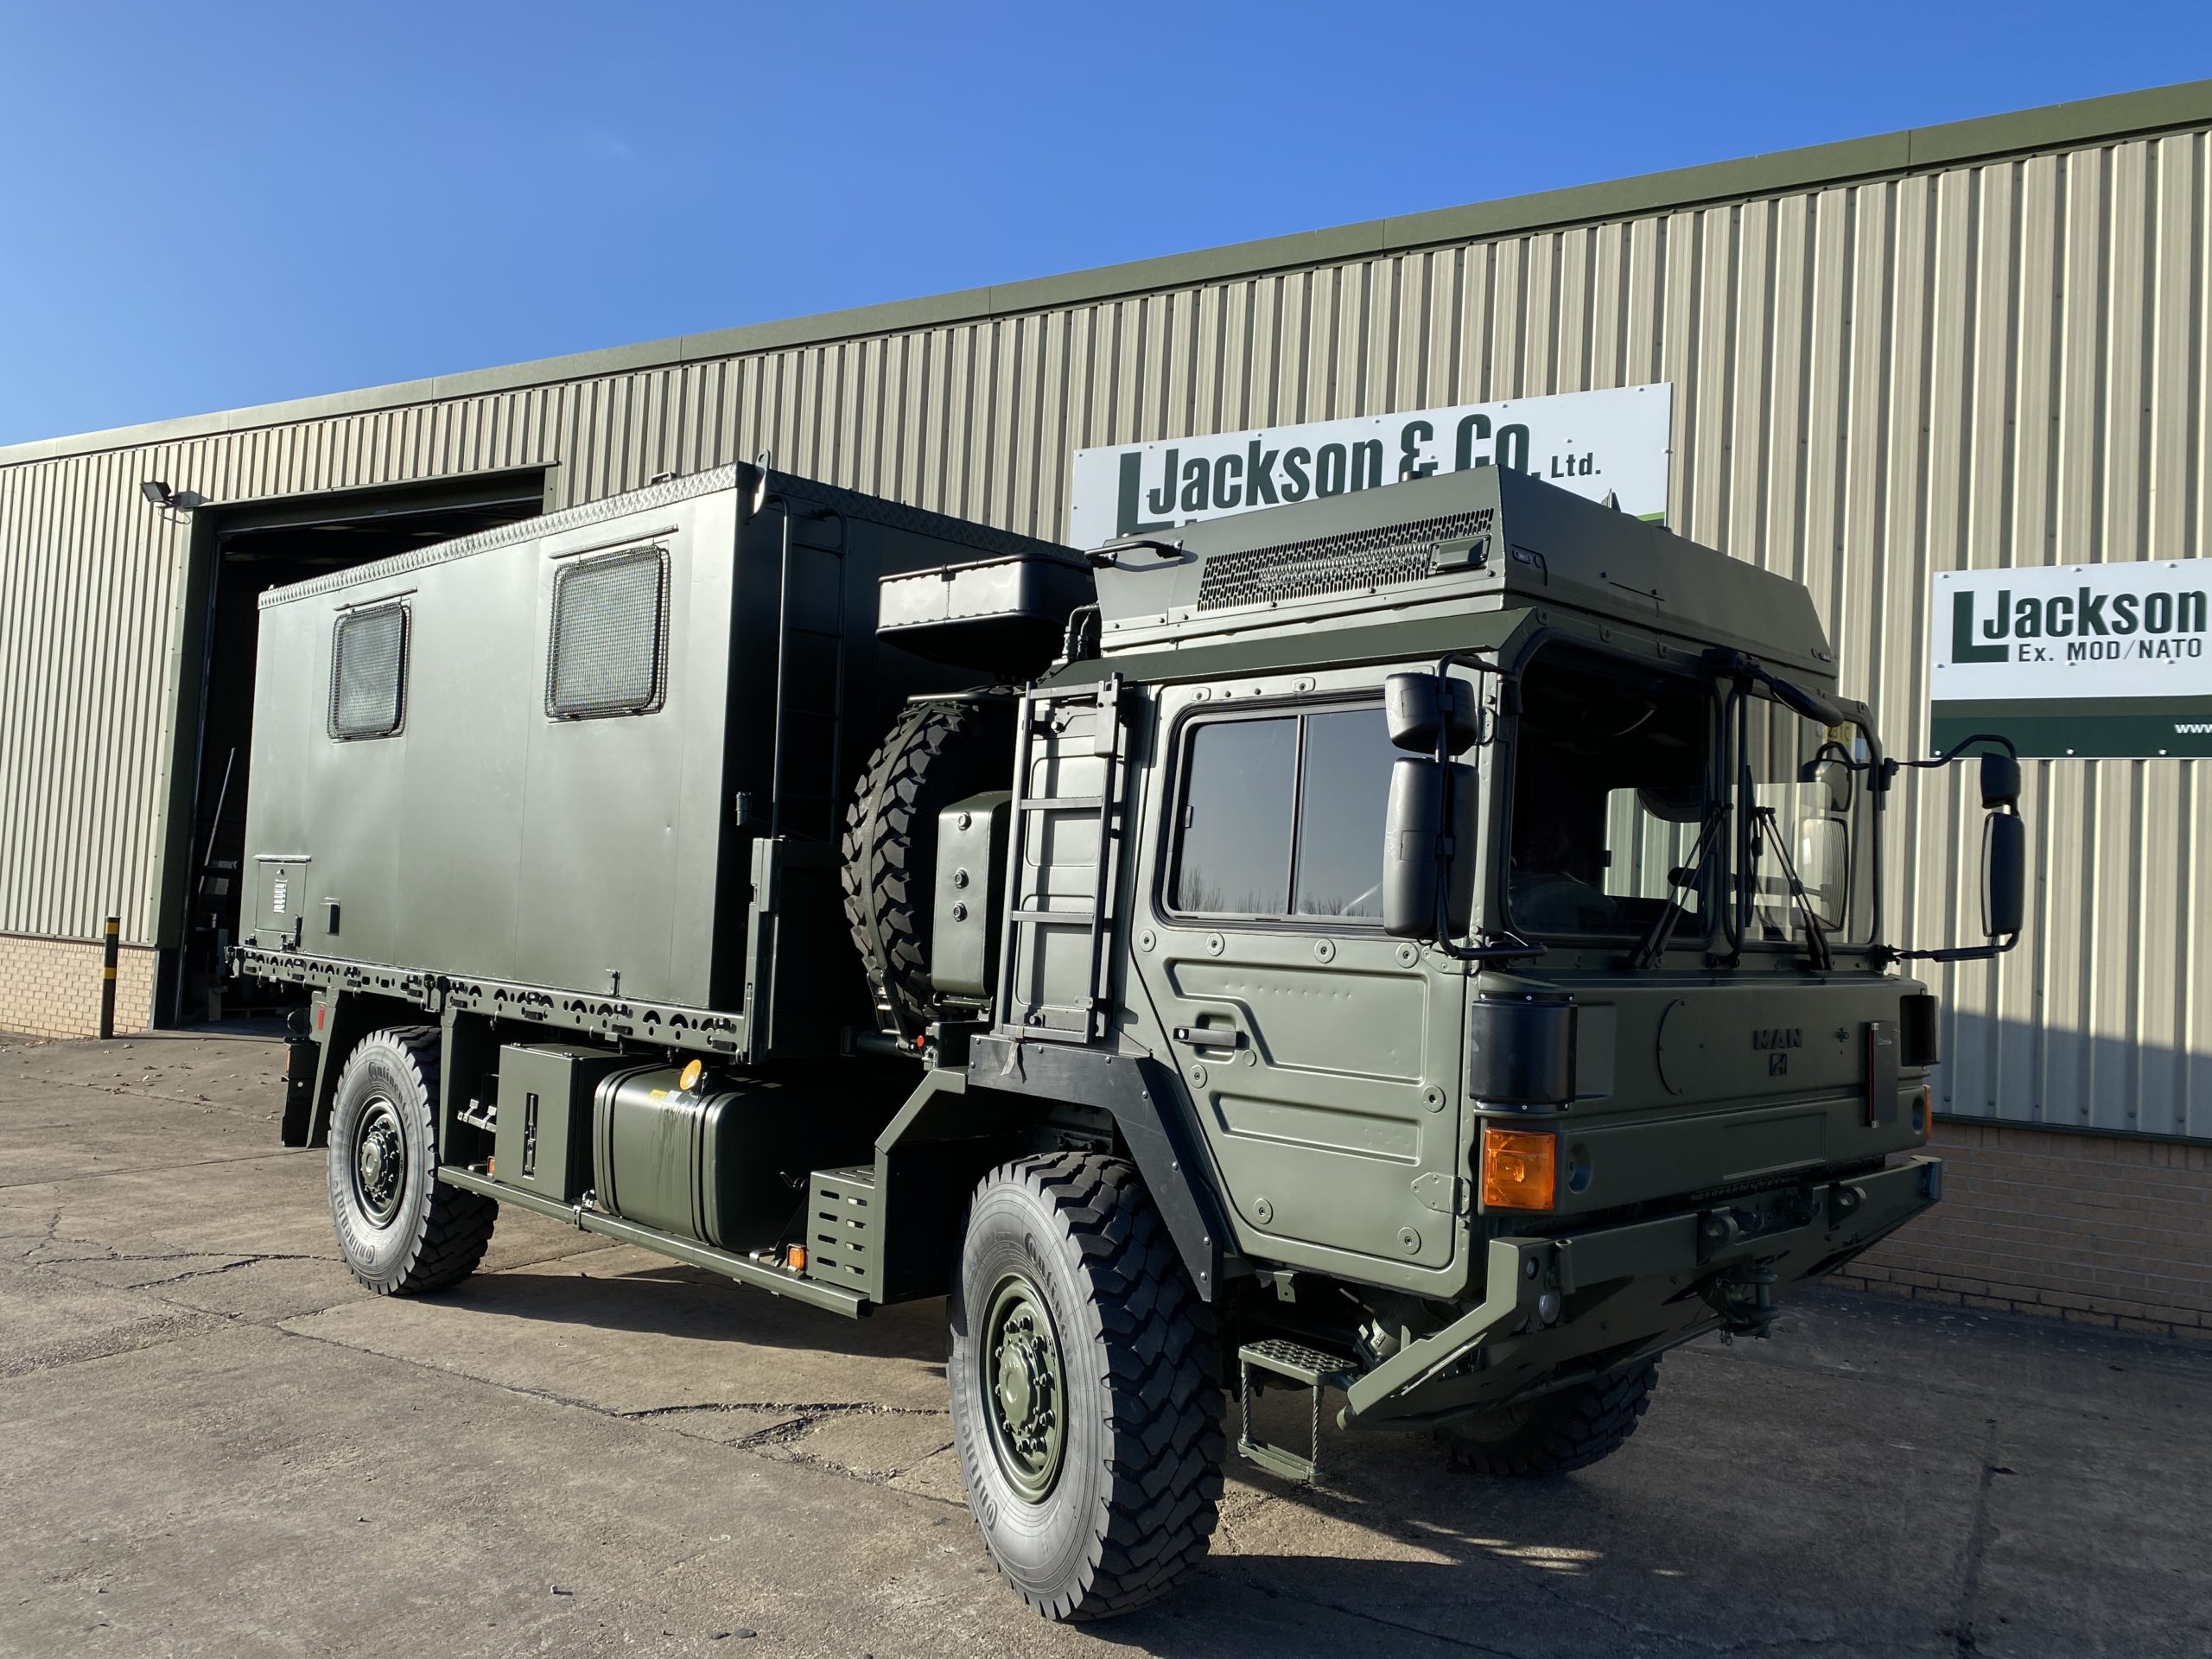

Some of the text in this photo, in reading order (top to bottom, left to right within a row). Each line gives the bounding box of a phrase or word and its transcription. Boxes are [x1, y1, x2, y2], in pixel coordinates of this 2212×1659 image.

[1148, 439, 1384, 515] Jackson
[1398, 419, 1440, 483] &
[1551, 452, 1602, 479] Ltd.
[1983, 586, 2208, 639] Jackson
[2018, 638, 2202, 662] Ex. MOD/NATO
[1752, 1027, 1803, 1051] MAN
